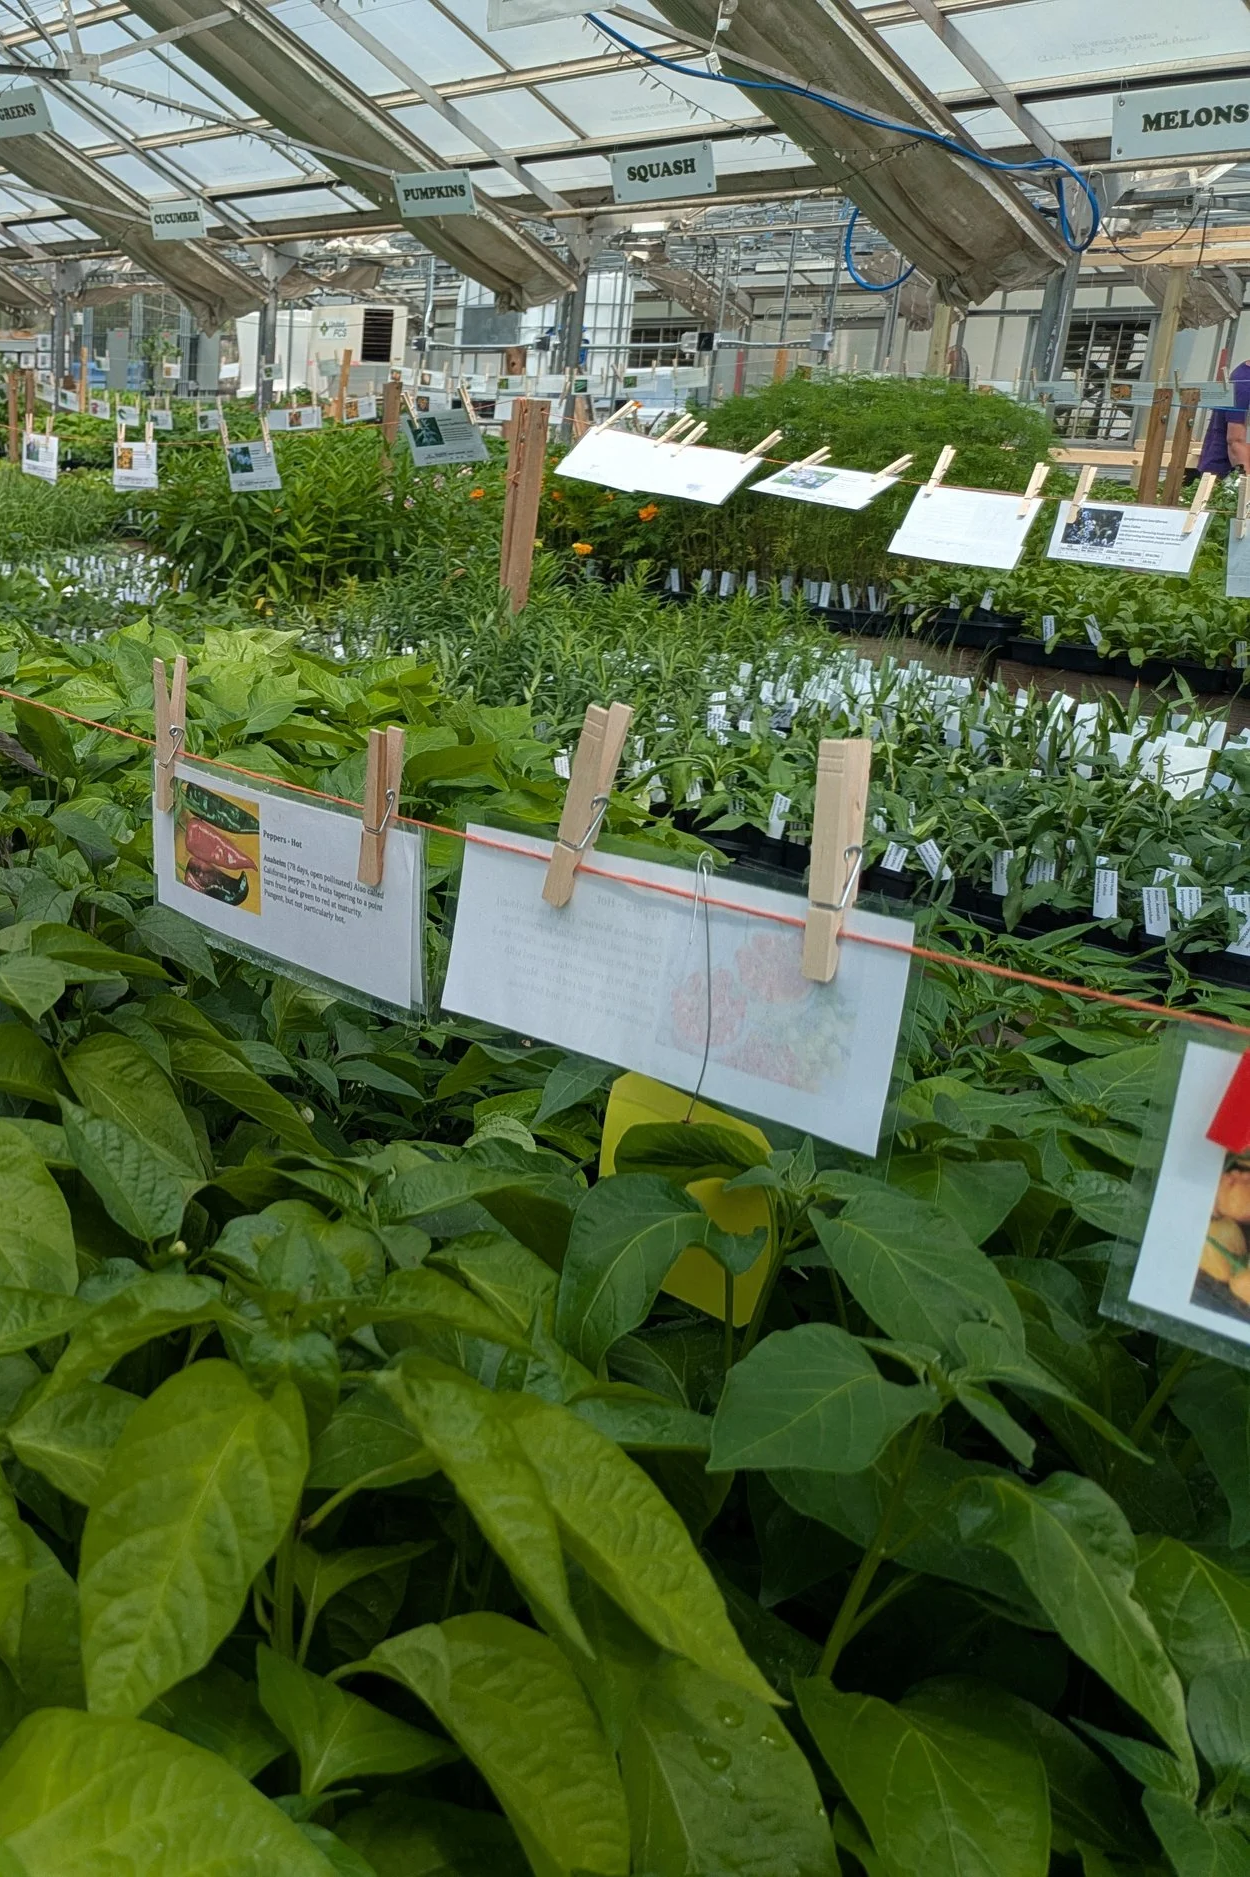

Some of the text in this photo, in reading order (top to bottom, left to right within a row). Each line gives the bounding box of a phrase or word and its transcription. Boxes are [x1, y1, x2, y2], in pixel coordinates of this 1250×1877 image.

[1141, 104, 1250, 133] MELONS
[626, 158, 696, 182] SQUASH
[403, 182, 467, 202] PUMPKINS
[153, 211, 201, 226] CUCUMBER
[1161, 770, 1190, 793] Dry
[263, 829, 287, 844] Peppers
[291, 838, 303, 849] Hot
[263, 865, 288, 880] California
[318, 883, 333, 896] fruits
[333, 889, 356, 905] tapering
[356, 897, 363, 906] to
[368, 899, 383, 912] point
[264, 854, 287, 868] Anaheim
[310, 870, 323, 881] open
[354, 883, 367, 894] Also
[366, 888, 385, 900] called
[264, 878, 363, 919] turn from dark green to red at maturity.
[285, 895, 294, 906] but
[294, 898, 303, 909] not
[303, 902, 334, 921] particularly
